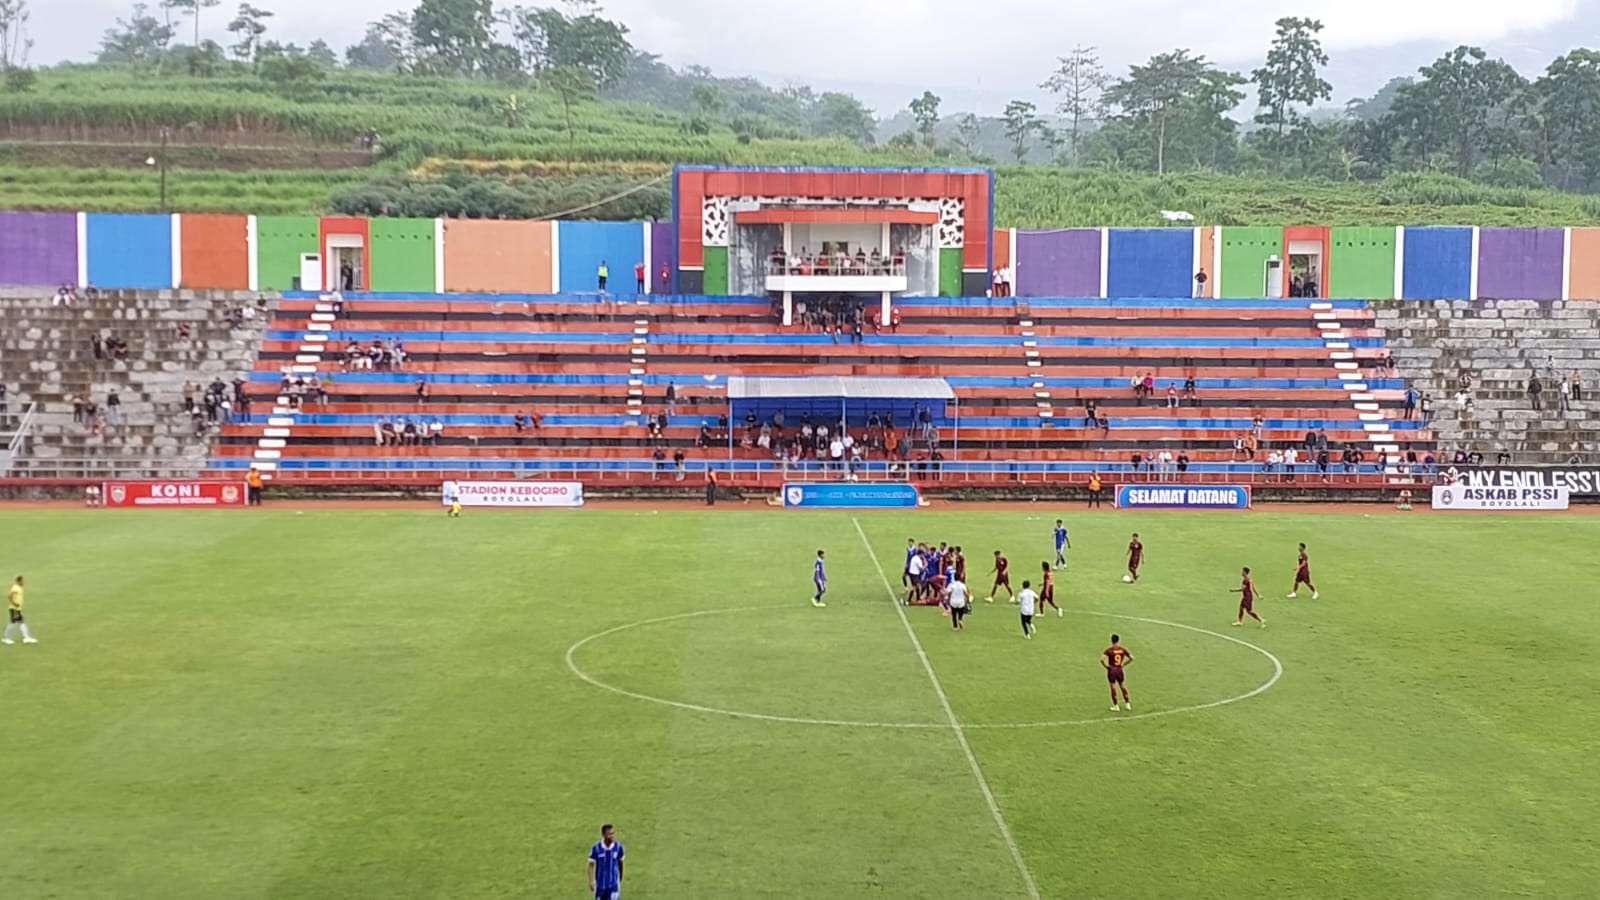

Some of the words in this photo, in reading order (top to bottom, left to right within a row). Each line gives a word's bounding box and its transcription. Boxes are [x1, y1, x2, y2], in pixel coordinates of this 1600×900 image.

[1469, 470, 1496, 486] MY
[1499, 470, 1592, 493] ENDLESS
[151, 484, 200, 497] KONI
[458, 485, 507, 495] STADION
[1463, 488, 1518, 500] ASKAB
[1521, 488, 1559, 500] PSSI
[483, 495, 544, 503] BOYOLALI
[1129, 489, 1186, 504] SELAMAT
[1187, 489, 1238, 505] DATANG
[1114, 654, 1122, 666] 9
